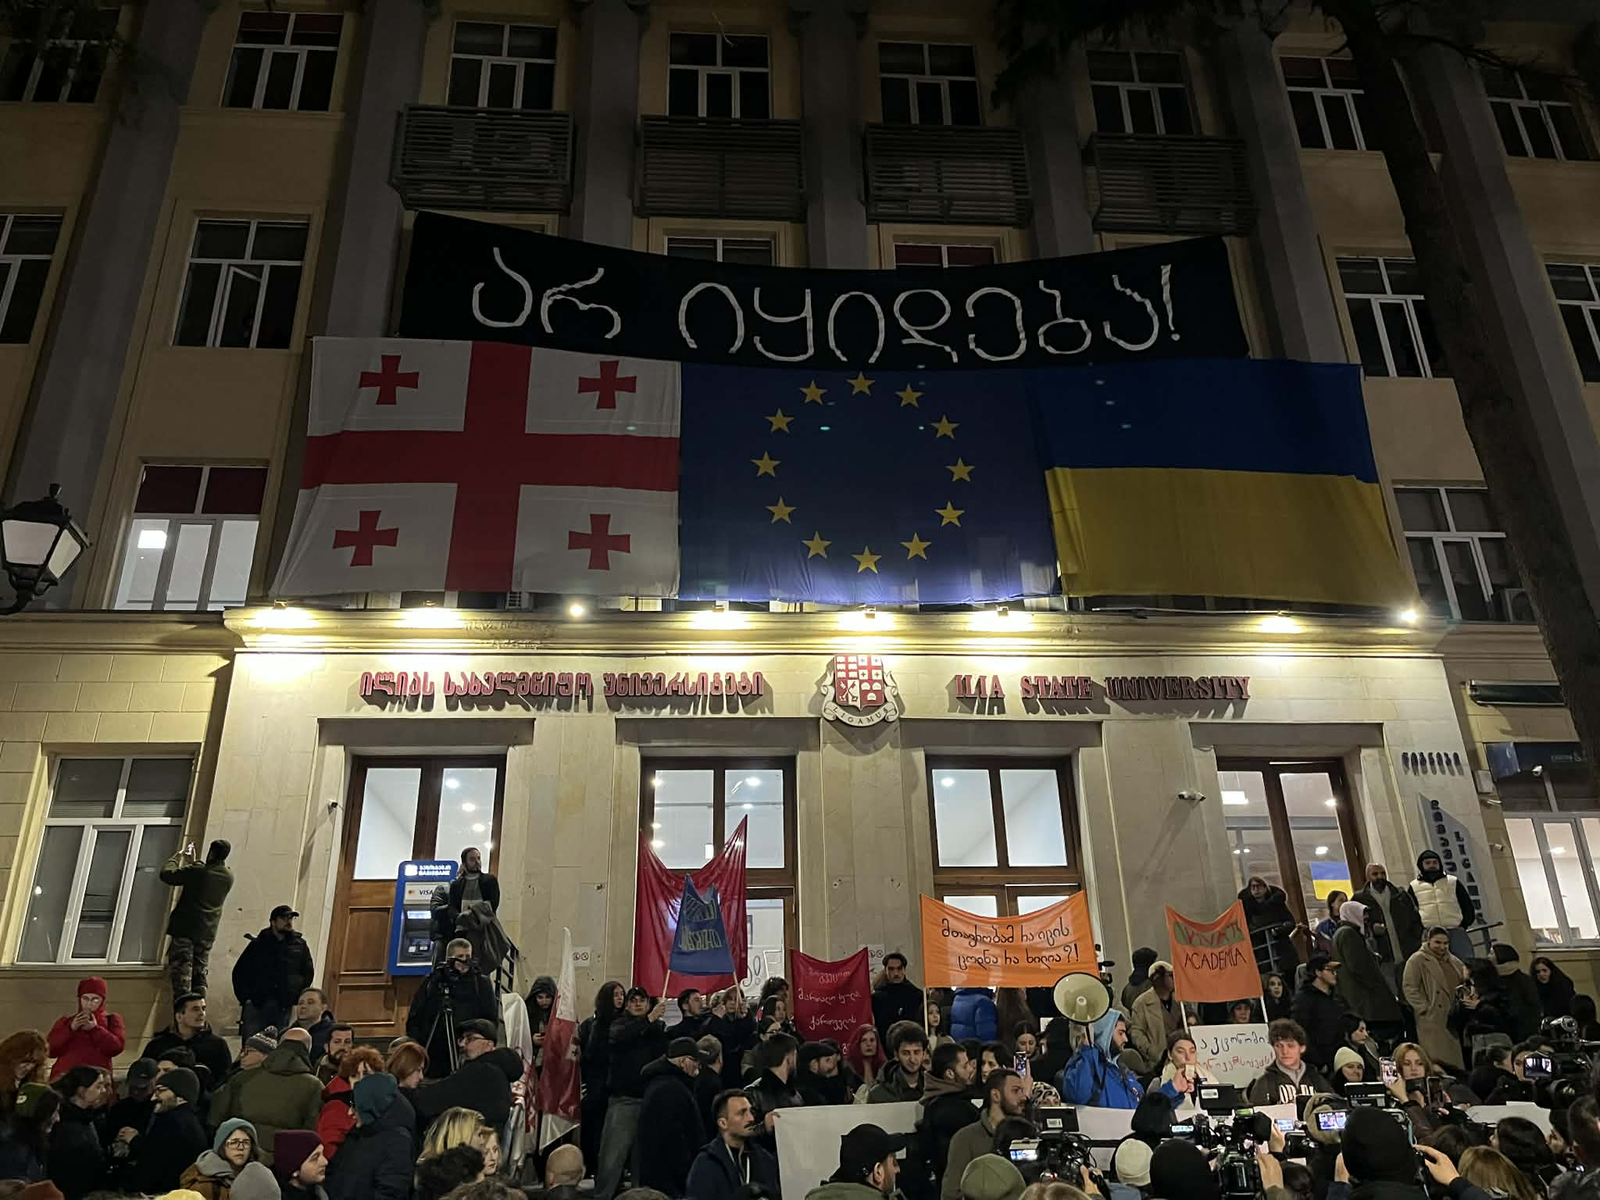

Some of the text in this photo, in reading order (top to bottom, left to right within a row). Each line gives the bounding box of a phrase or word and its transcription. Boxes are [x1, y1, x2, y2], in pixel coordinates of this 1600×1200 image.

[472, 247, 1182, 363] არ იყიდება!
[359, 671, 765, 697] ილიას სახელმწიფო უნივერსიტეტი
[954, 674, 1251, 700] ILIA STATE UNIVERSITY
[941, 918, 1015, 948] მთავრობამ
[1184, 947, 1247, 971] ACADEMIA
